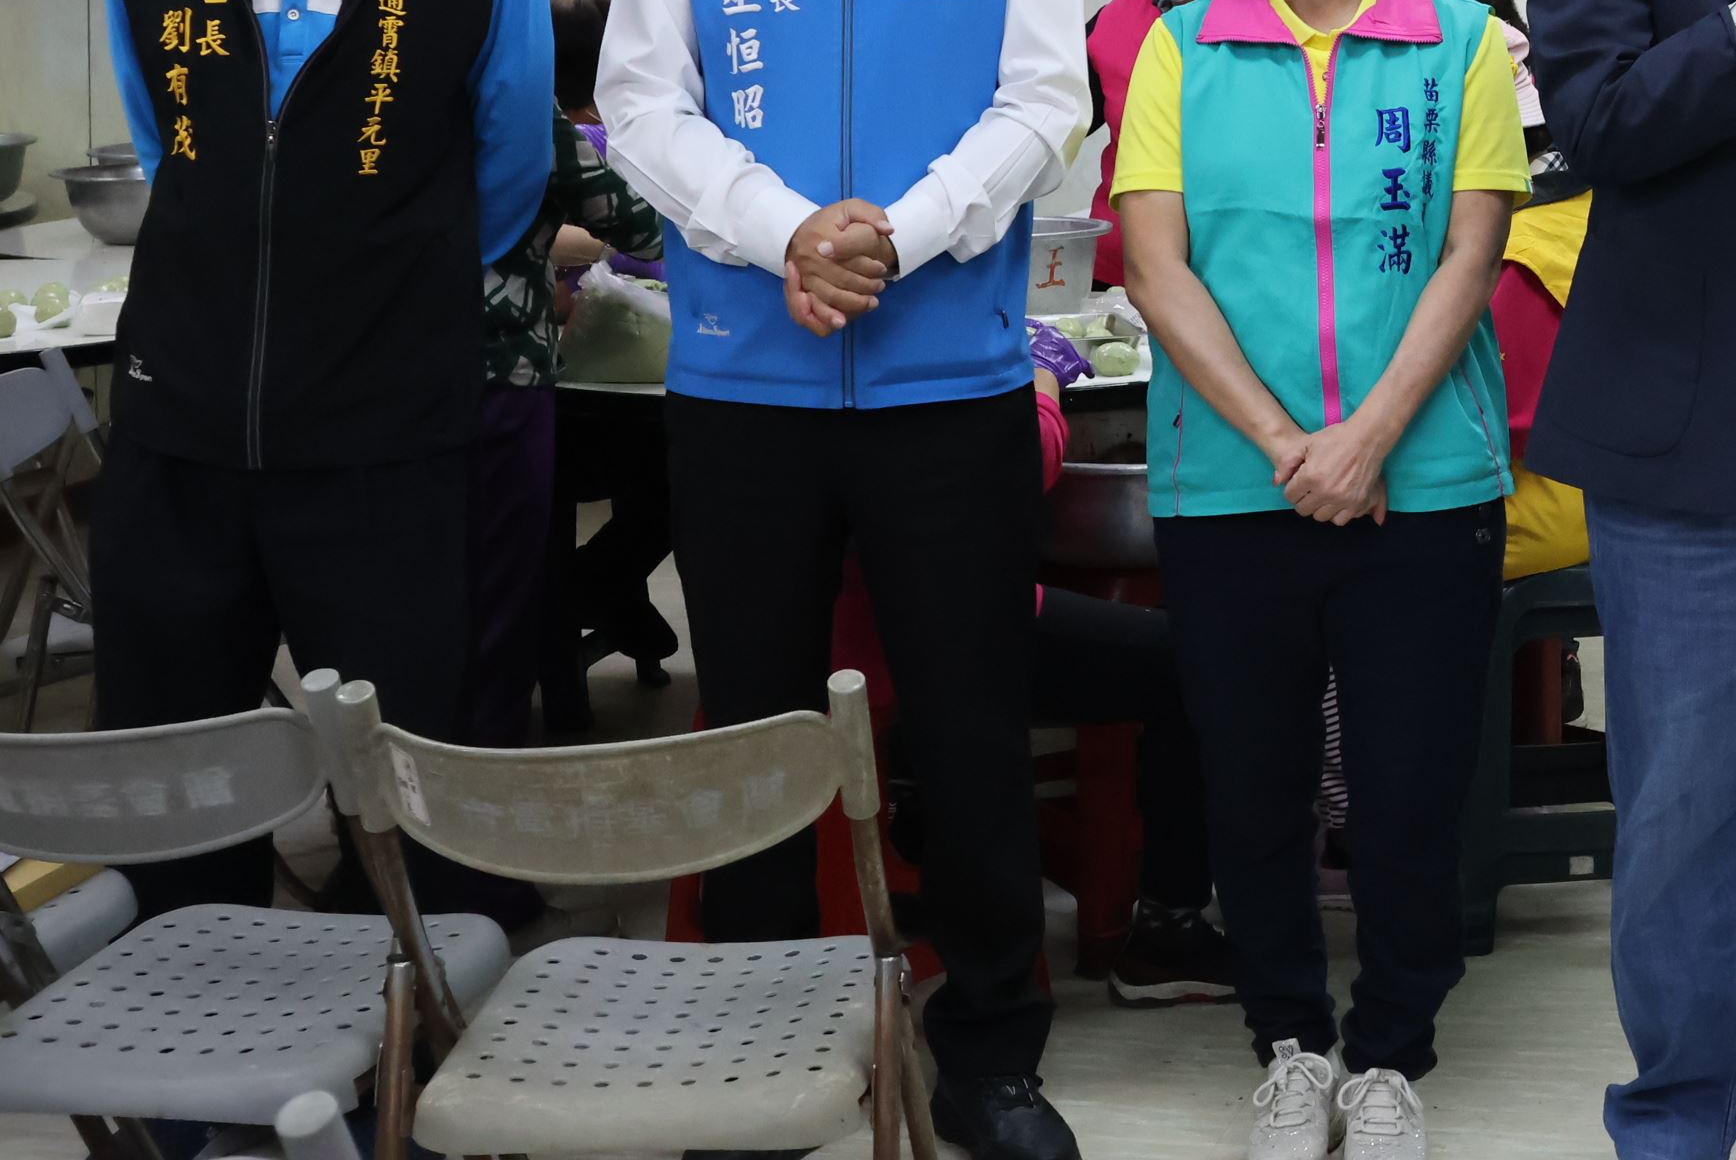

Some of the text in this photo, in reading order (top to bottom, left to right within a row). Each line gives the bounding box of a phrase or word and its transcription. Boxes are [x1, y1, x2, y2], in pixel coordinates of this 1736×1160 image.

[159, 6, 198, 161] 劉有茂
[1421, 77, 1441, 220] 苗栗縣議
[1374, 106, 1413, 276] 周玉滿
